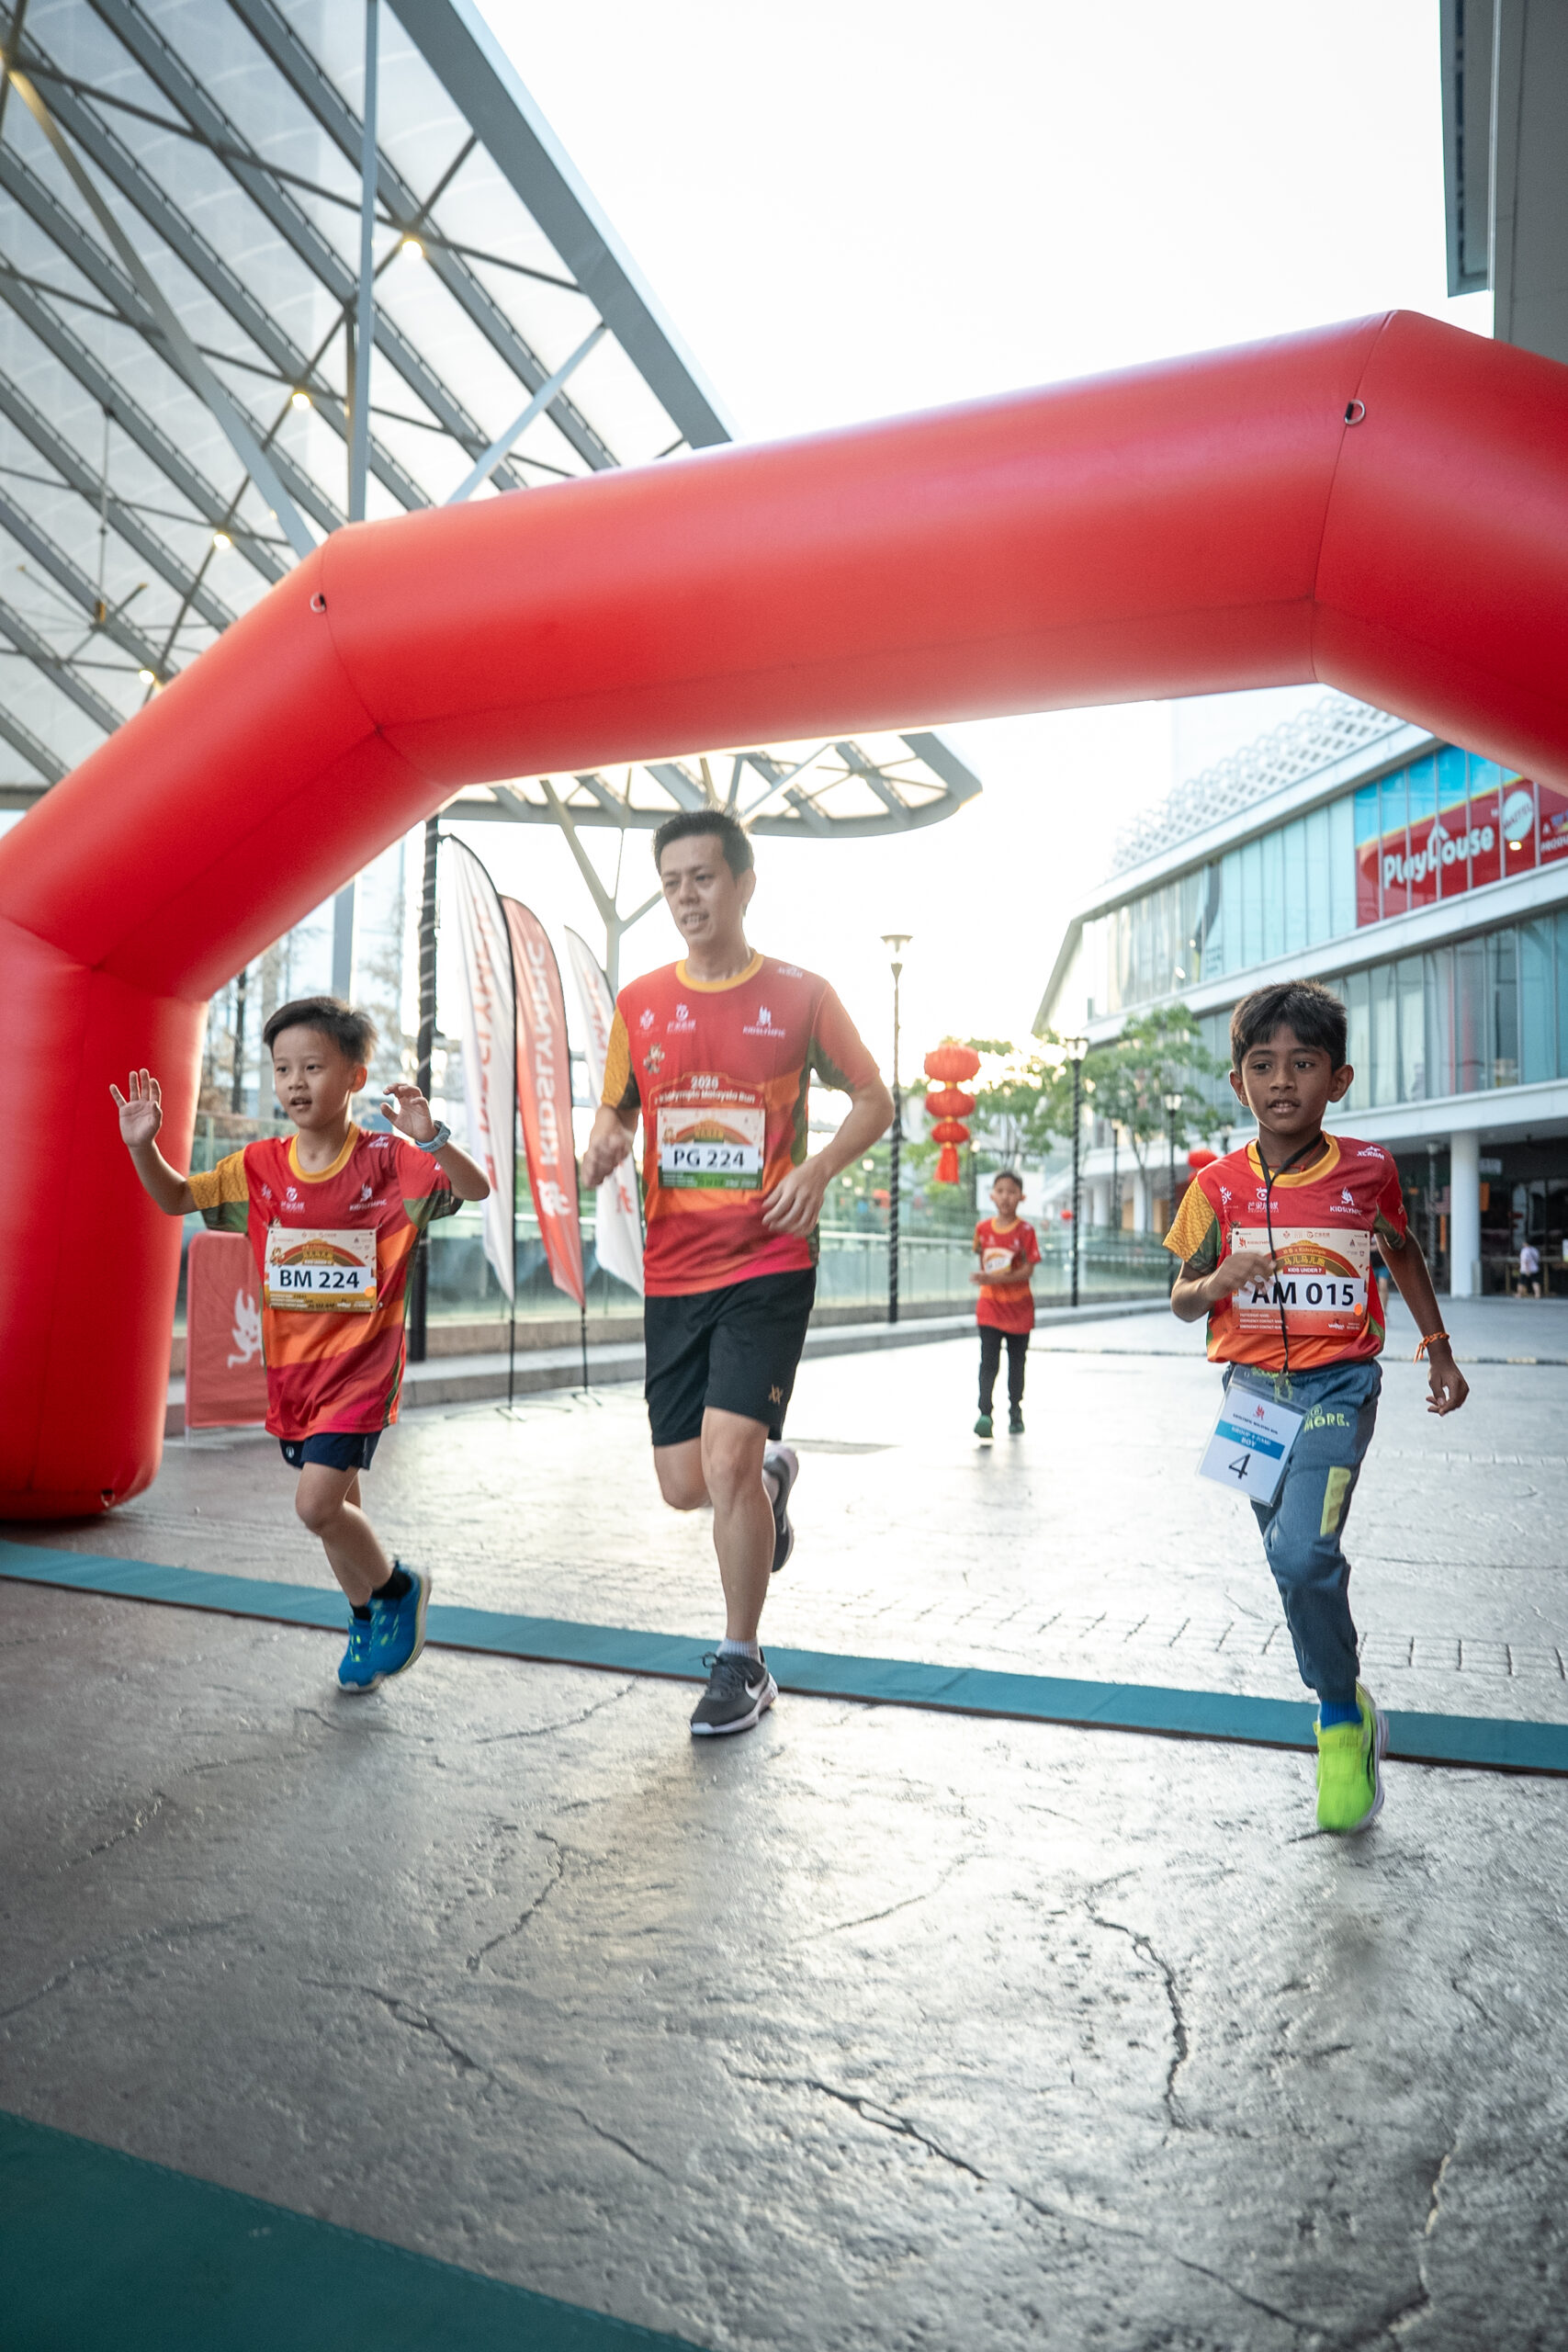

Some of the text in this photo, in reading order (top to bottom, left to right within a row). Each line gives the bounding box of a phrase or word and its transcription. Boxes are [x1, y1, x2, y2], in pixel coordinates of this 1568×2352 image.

[1383, 825, 1495, 889] Playhouse
[673, 1148, 744, 1169] PG 224
[279, 1269, 360, 1289] BM 224
[1251, 1282, 1355, 1306] AM 015
[1228, 1453, 1251, 1479] 4
